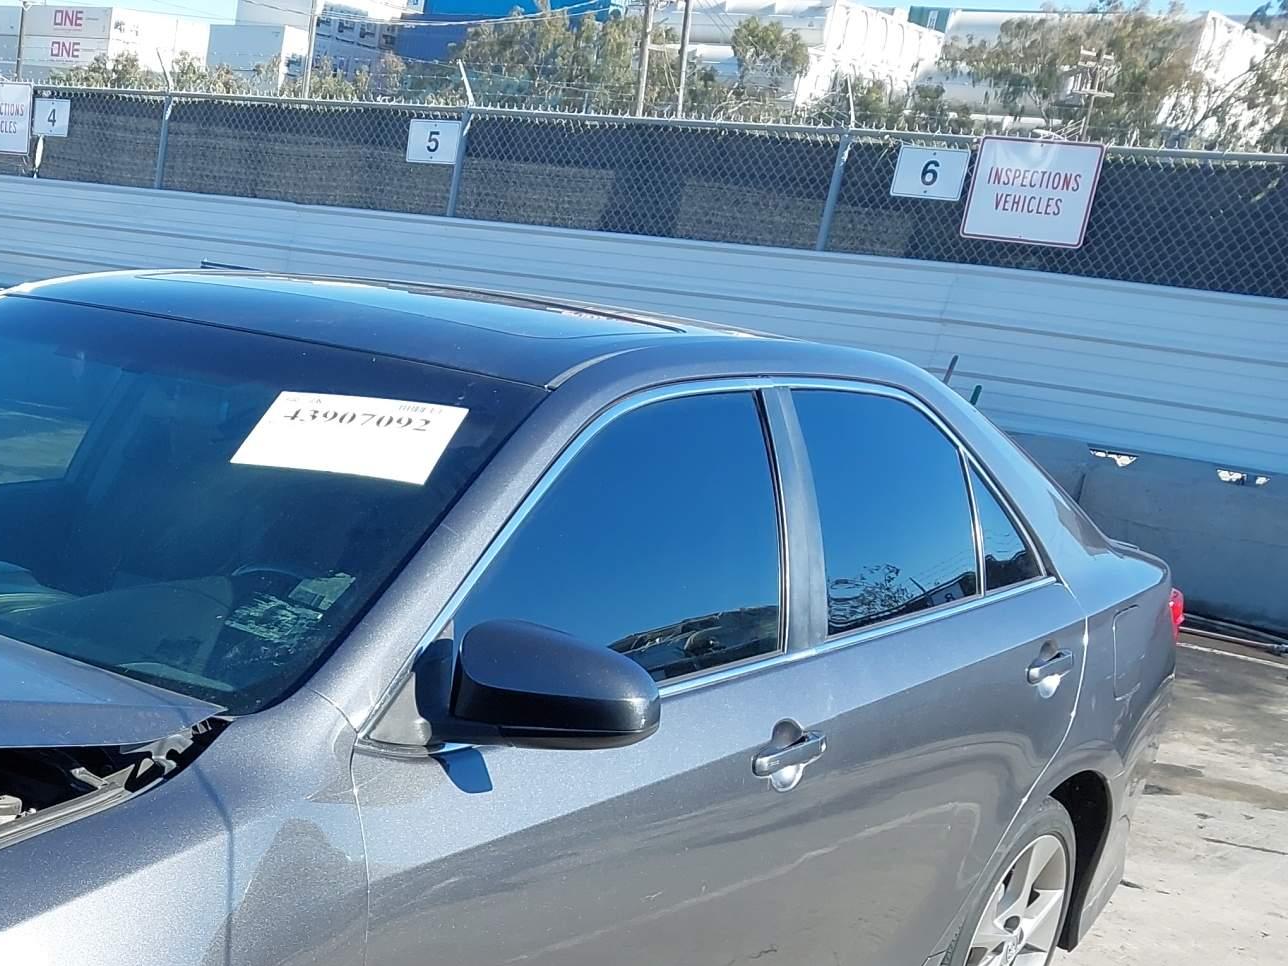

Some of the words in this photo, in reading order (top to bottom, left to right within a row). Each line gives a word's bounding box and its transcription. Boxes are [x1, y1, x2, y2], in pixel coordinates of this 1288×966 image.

[53, 9, 84, 27] ONE
[50, 40, 81, 58] ONE
[47, 108, 57, 127] 4
[426, 130, 441, 153] 5
[920, 159, 940, 187] 6
[986, 165, 1083, 193] INSPECTIONS
[993, 192, 1064, 217] VEHICLES
